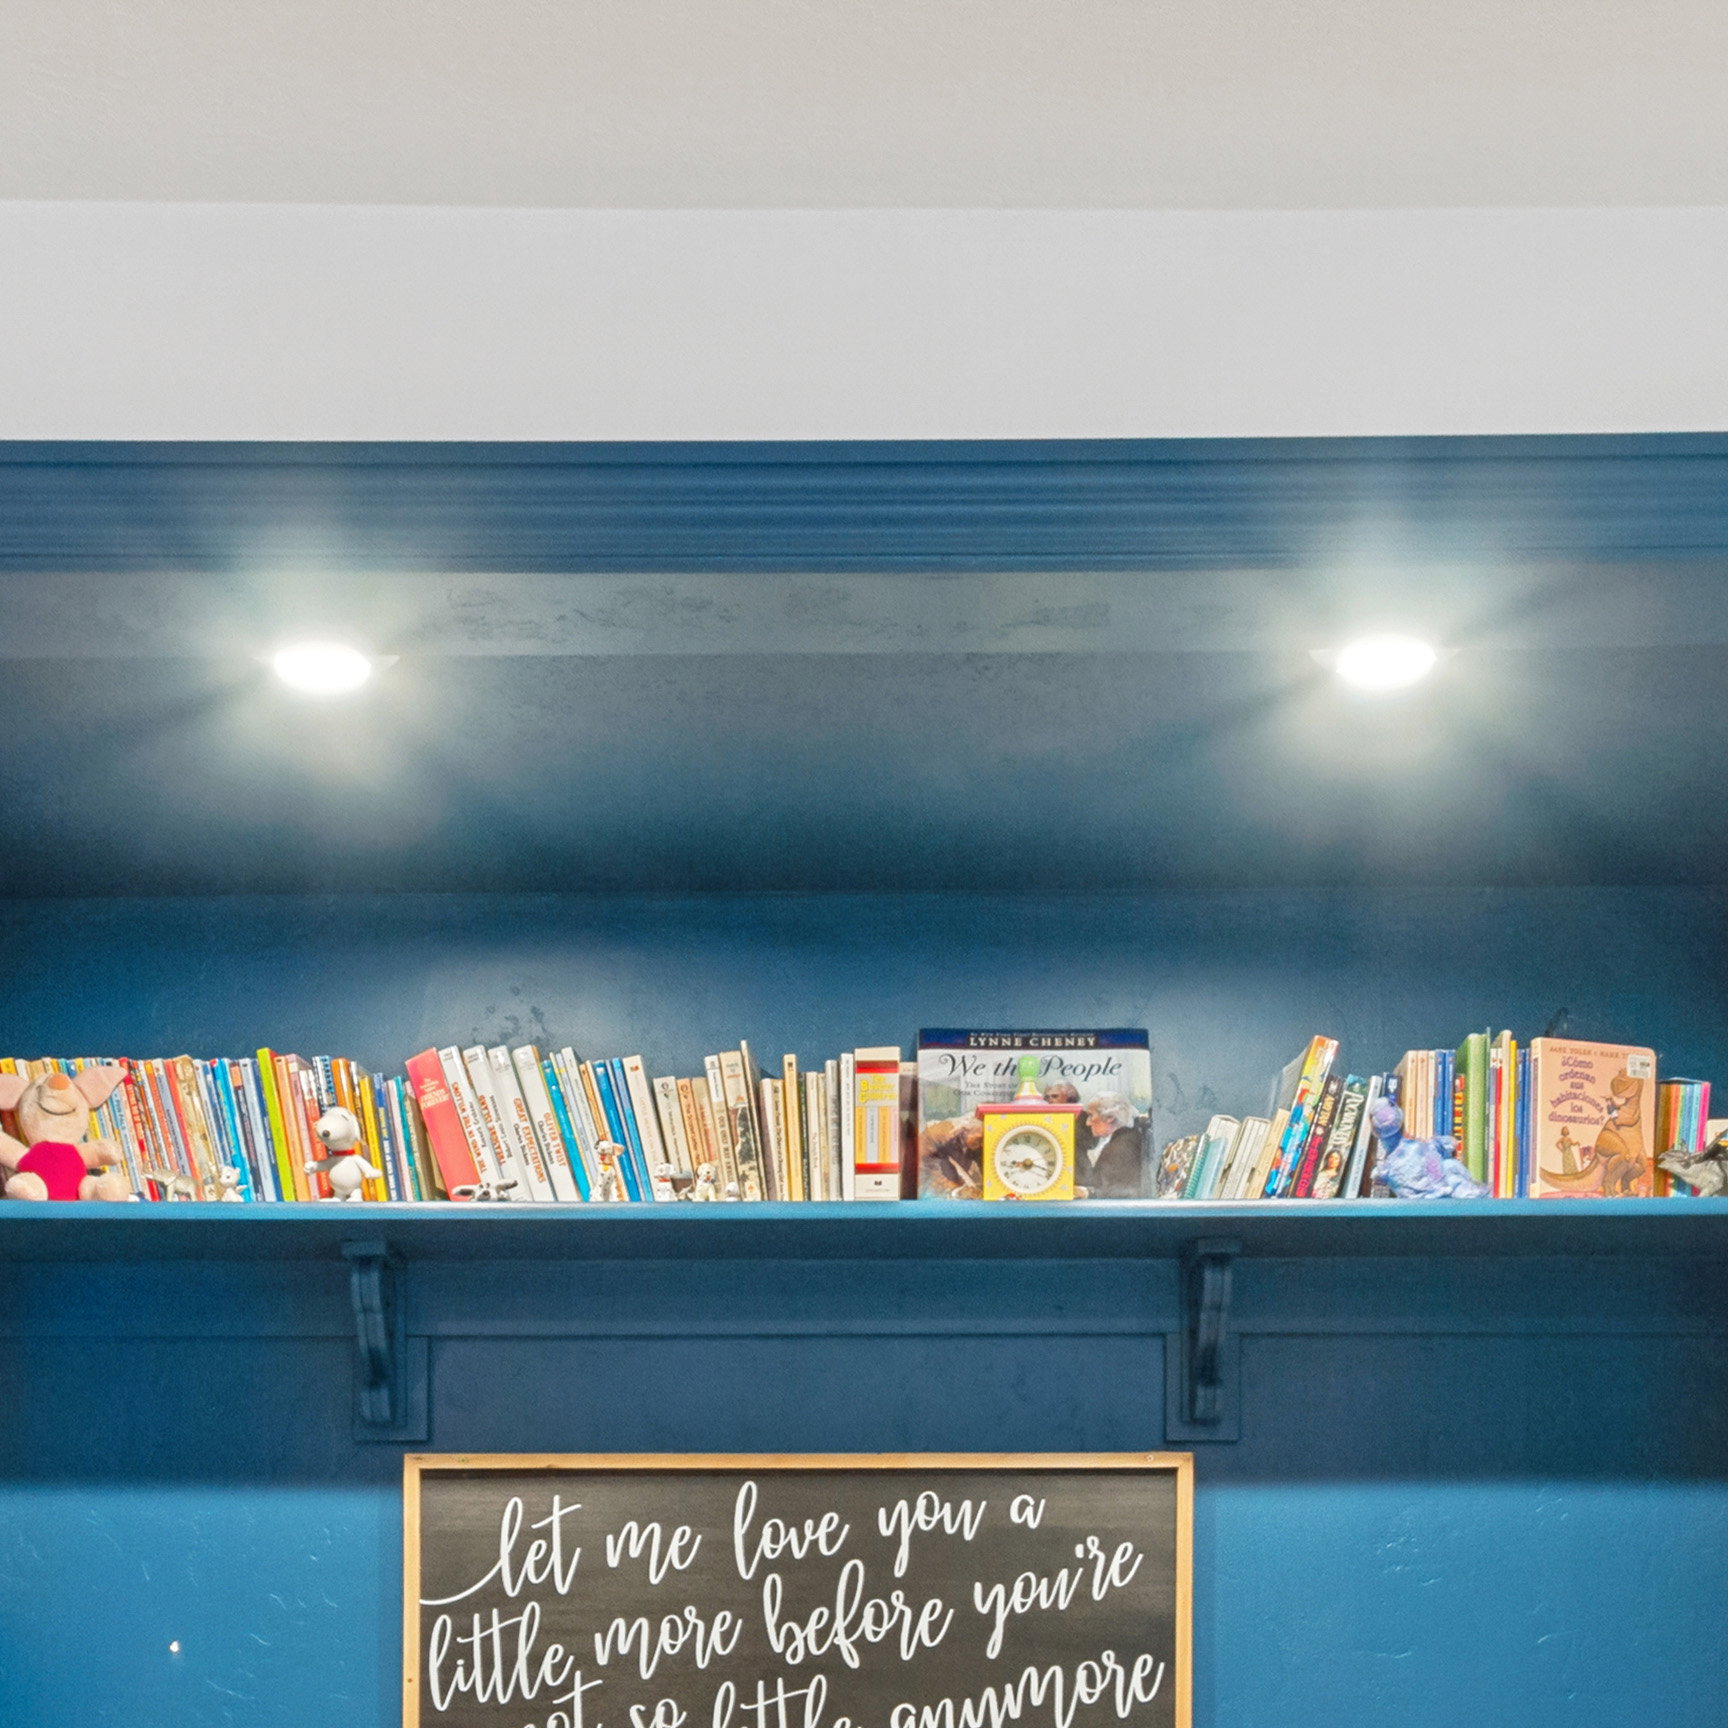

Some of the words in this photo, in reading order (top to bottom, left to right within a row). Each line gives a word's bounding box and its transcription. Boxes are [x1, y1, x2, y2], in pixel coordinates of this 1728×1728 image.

[969, 1036, 1023, 1047] LYNNE
[1029, 1036, 1096, 1047] CHENEY
[938, 1053, 986, 1077] We
[993, 1057, 1018, 1077] th
[1038, 1054, 1123, 1082] People
[1558, 1068, 1597, 1085] ordenan
[451, 1082, 466, 1113] WILLOWS
[477, 1094, 492, 1123] ISLAND
[462, 1115, 472, 1129] THE
[472, 1139, 482, 1157] WIND
[488, 1125, 506, 1166] TREASURE
[513, 1097, 528, 1122] GREAT
[522, 1126, 547, 1183] EXPECTATIONS
[513, 1123, 523, 1144] Charles
[520, 1145, 530, 1166] Dickens
[537, 1120, 547, 1142] Charles
[544, 1142, 554, 1165] Dickens
[543, 1112, 558, 1141] OLIVER
[553, 1143, 567, 1166] TWIST
[478, 1159, 488, 1173] THE
[419, 1494, 583, 1604] let
[605, 1518, 702, 1584] me
[732, 1480, 850, 1580] love
[877, 1489, 987, 1578] you
[1009, 1493, 1046, 1530] a
[429, 1600, 575, 1712] little
[594, 1606, 743, 1680] more
[762, 1557, 956, 1669] before
[972, 1534, 1145, 1660] you're
